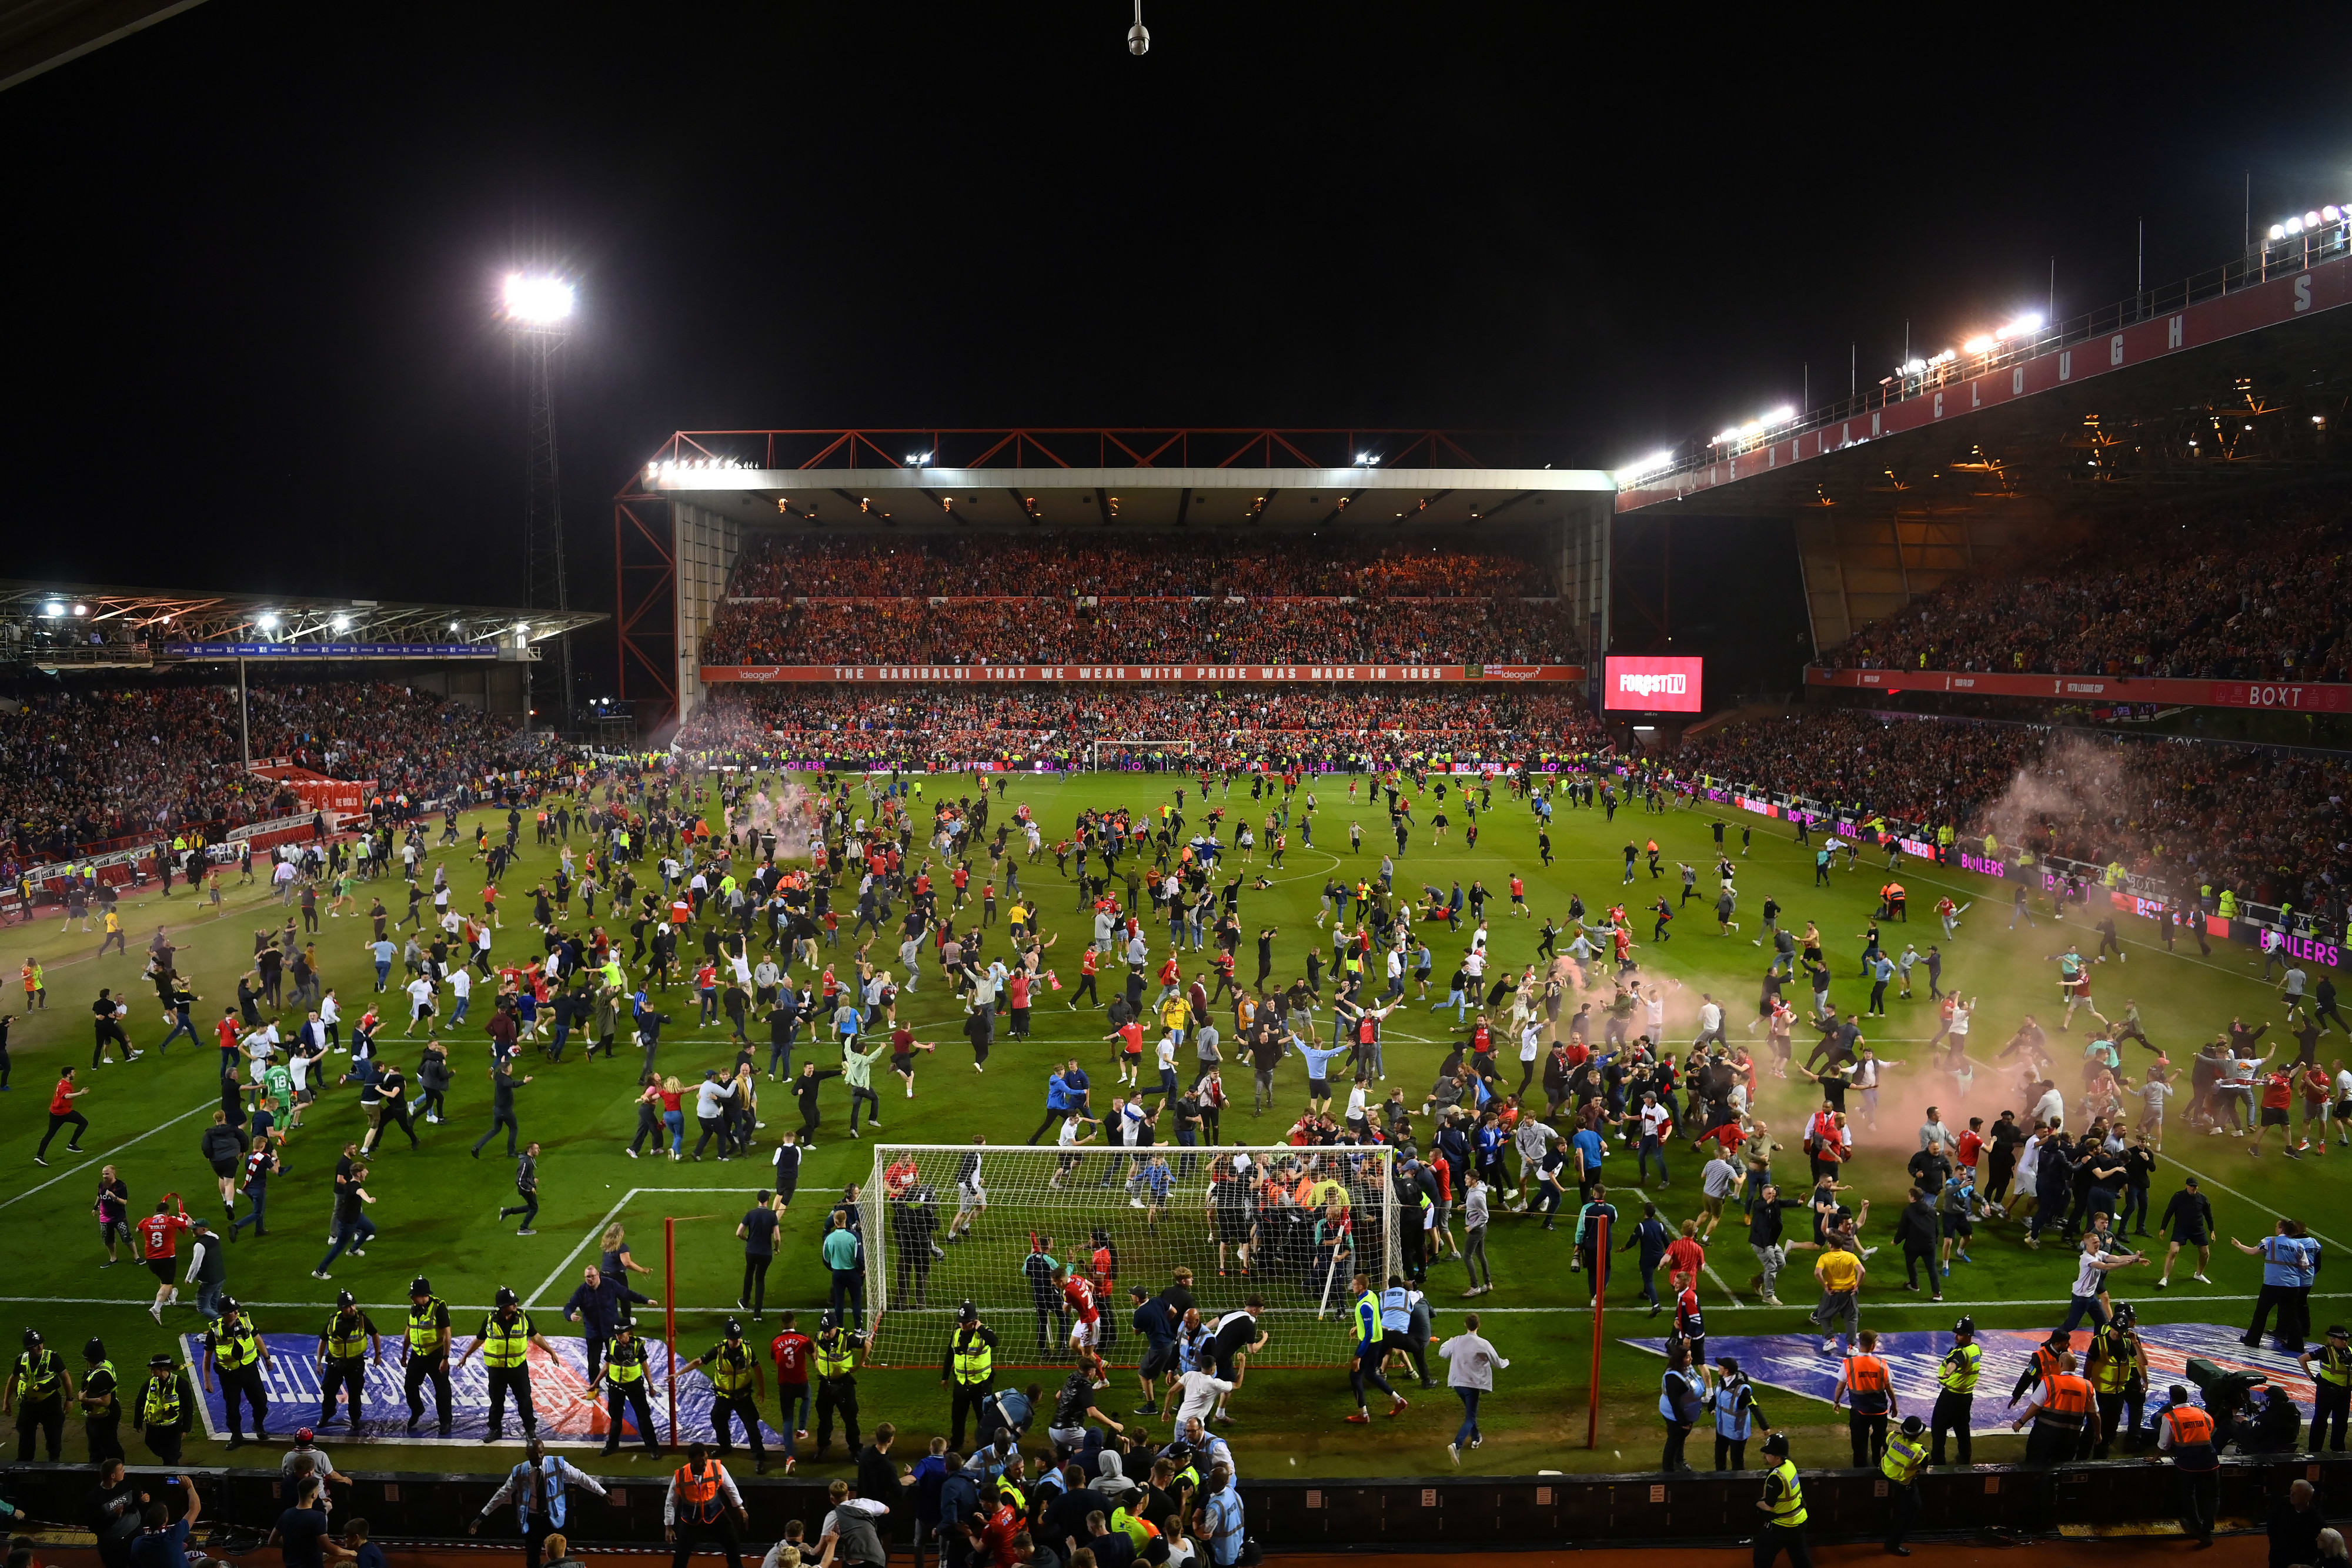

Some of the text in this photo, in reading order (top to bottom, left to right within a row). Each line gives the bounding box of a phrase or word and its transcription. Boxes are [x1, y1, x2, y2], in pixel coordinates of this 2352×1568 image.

[1769, 413, 1880, 467] BRIAN
[1935, 315, 2182, 418] CLOUGH
[739, 671, 774, 681] Ideagen
[834, 668, 1441, 679] THE GARIBALDI THAT WE WEAR WITH PRIDE WAS MADE IN 1865
[1502, 670, 1536, 680] Ideagen
[2250, 686, 2302, 707] BOXT
[1744, 798, 1768, 815] BOILERS
[273, 1075, 287, 1089] 18
[151, 1232, 163, 1248] 8
[777, 1339, 800, 1349] PEARCE
[784, 1346, 795, 1369] 3
[2182, 1420, 2204, 1429] SAFETY TEAM
[1892, 1440, 1916, 1459] POLICE
[109, 1495, 127, 1510] BOSS
